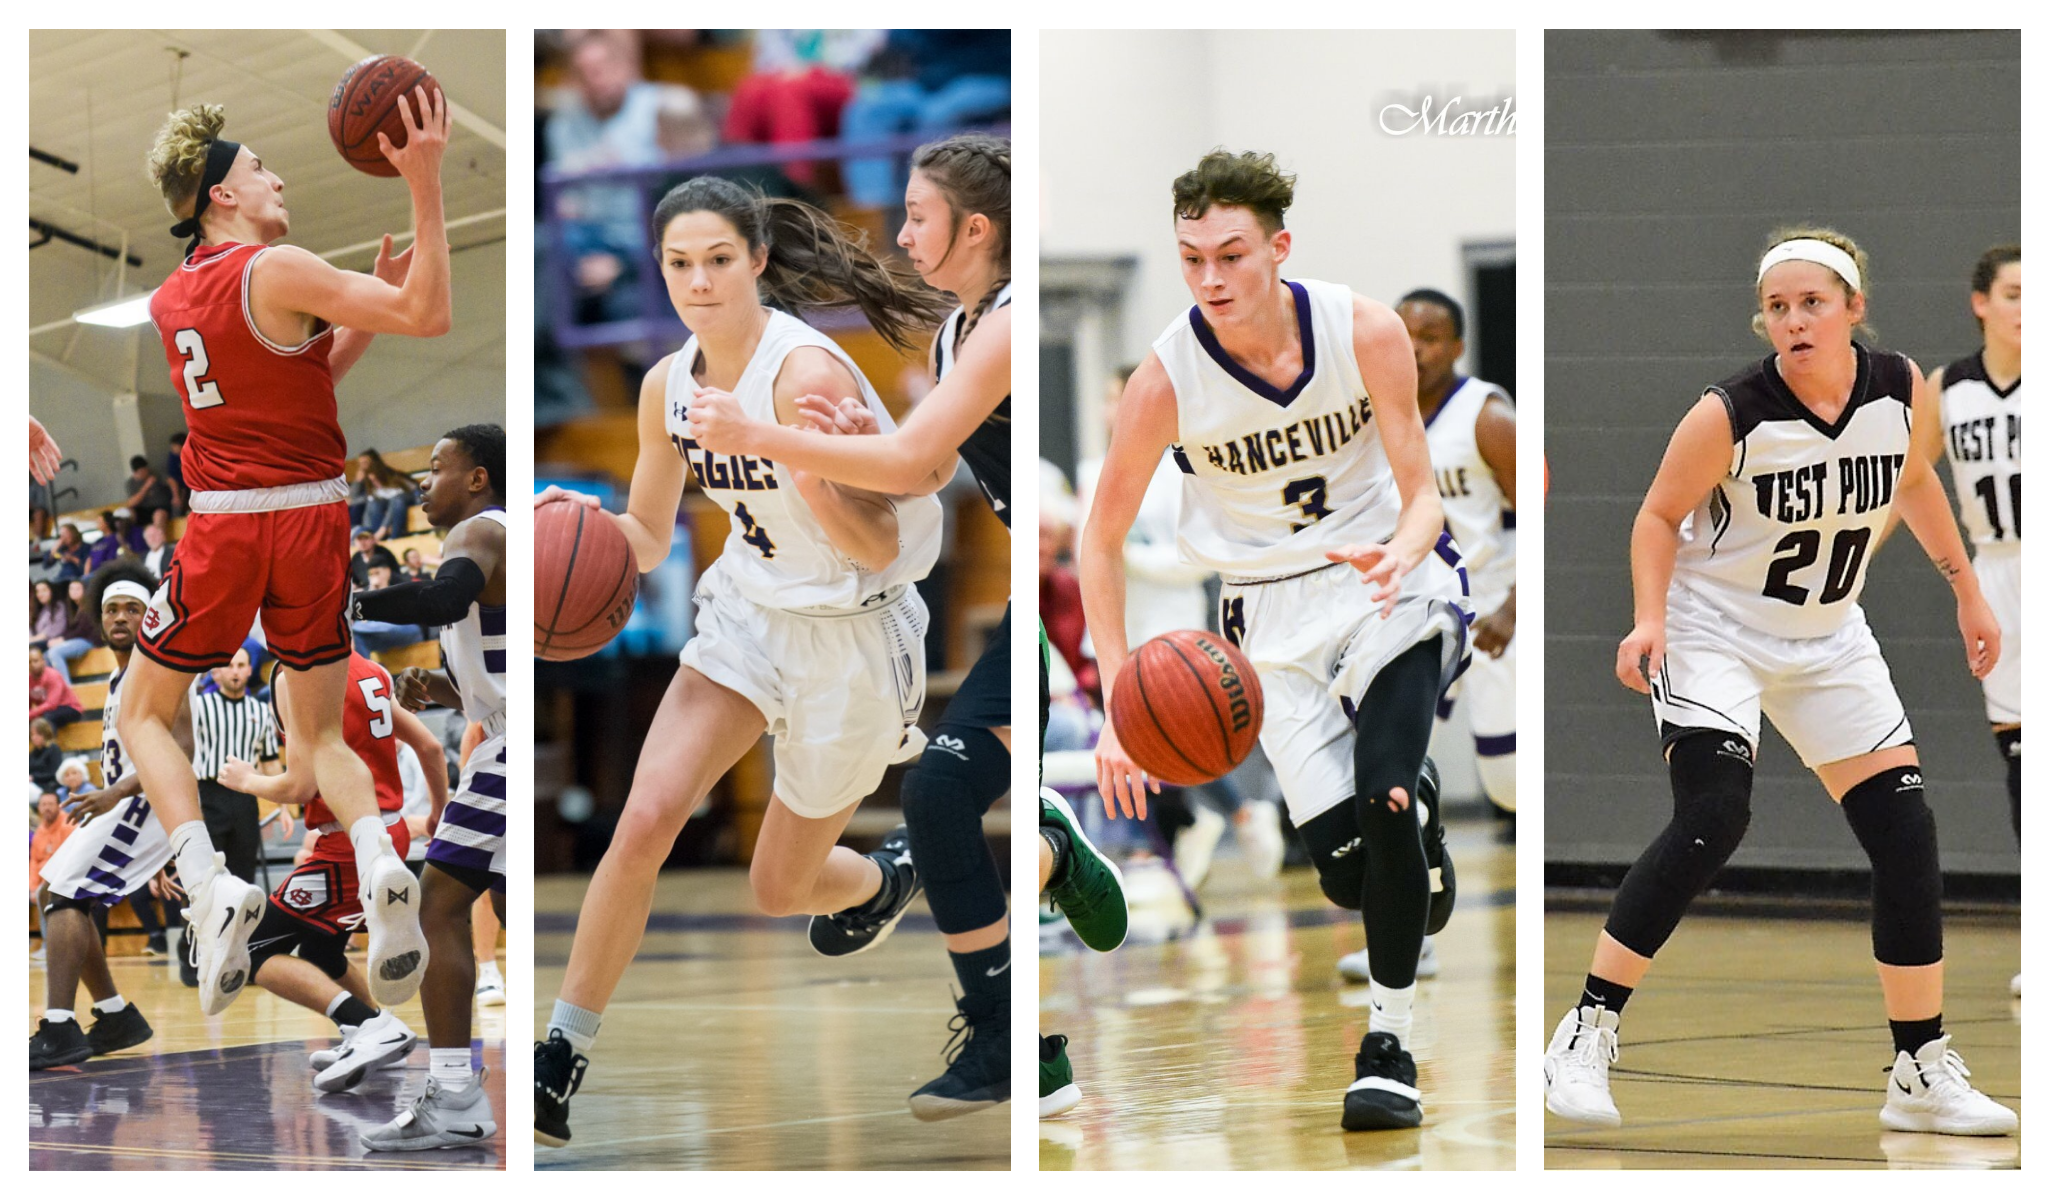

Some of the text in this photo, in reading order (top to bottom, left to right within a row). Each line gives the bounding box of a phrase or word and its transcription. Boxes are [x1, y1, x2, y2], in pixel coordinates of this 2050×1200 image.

[174, 328, 225, 410] 2
[1203, 397, 1373, 475] HANCEVILLE
[734, 500, 778, 560] 4
[1279, 472, 1336, 536] 3
[1762, 526, 1871, 607] 20
[357, 676, 393, 739] 5
[121, 795, 152, 829] H
